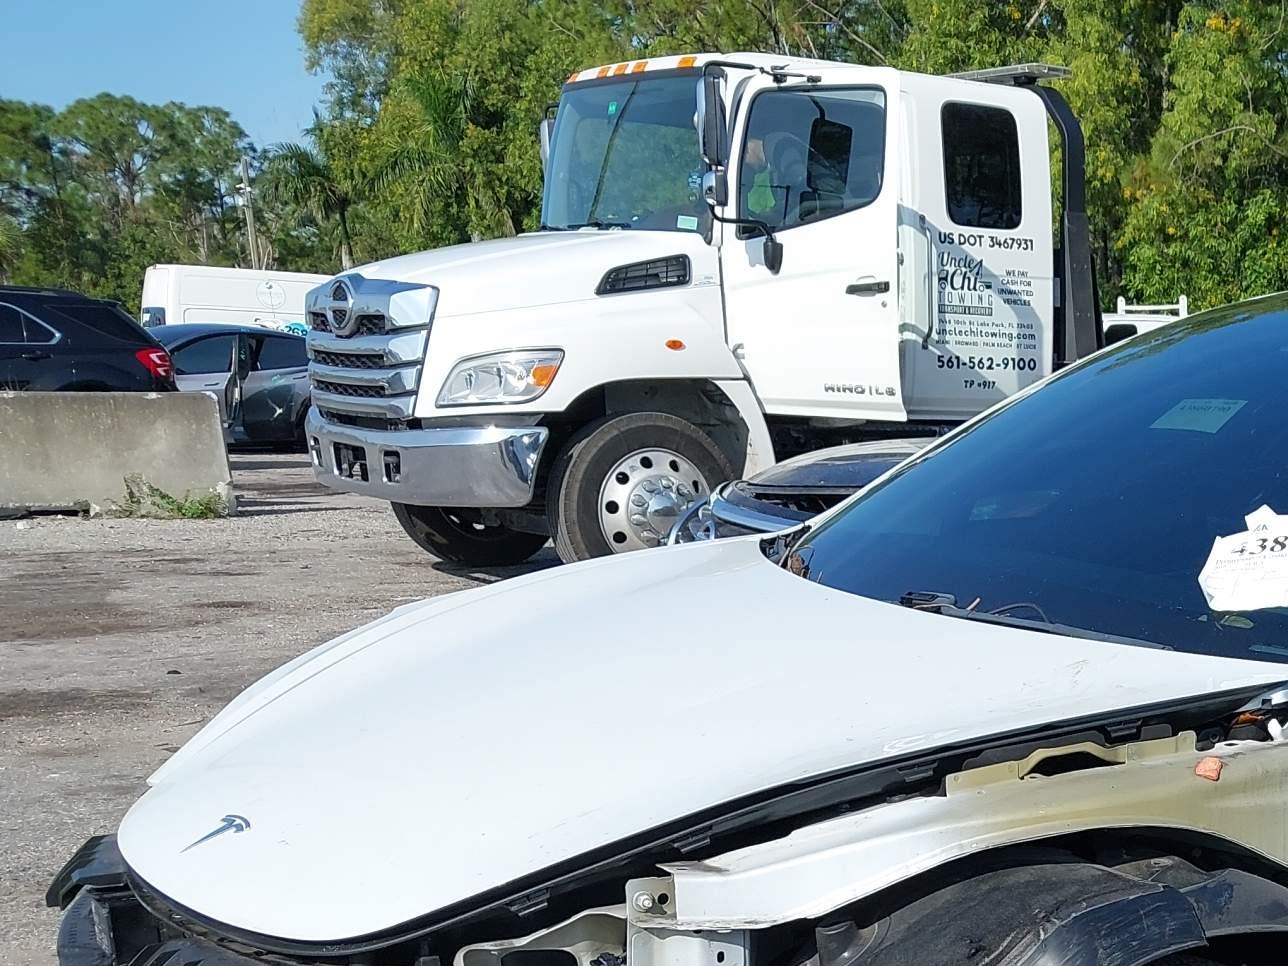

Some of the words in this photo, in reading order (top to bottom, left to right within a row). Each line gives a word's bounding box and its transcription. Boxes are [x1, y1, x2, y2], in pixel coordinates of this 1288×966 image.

[938, 232, 954, 245] US
[958, 233, 984, 247] DOT
[988, 235, 1034, 251] 3467931
[938, 251, 976, 268] Uncle
[1005, 269, 1016, 277] WE
[1017, 270, 1029, 278] PAY
[938, 291, 993, 306] TOWING
[997, 287, 1034, 297] UNWANTED
[1002, 298, 1031, 306] VEHICLES
[935, 327, 1036, 342] unclechitowing.com
[937, 354, 1037, 371] 561-562-9100
[963, 380, 975, 389] TP
